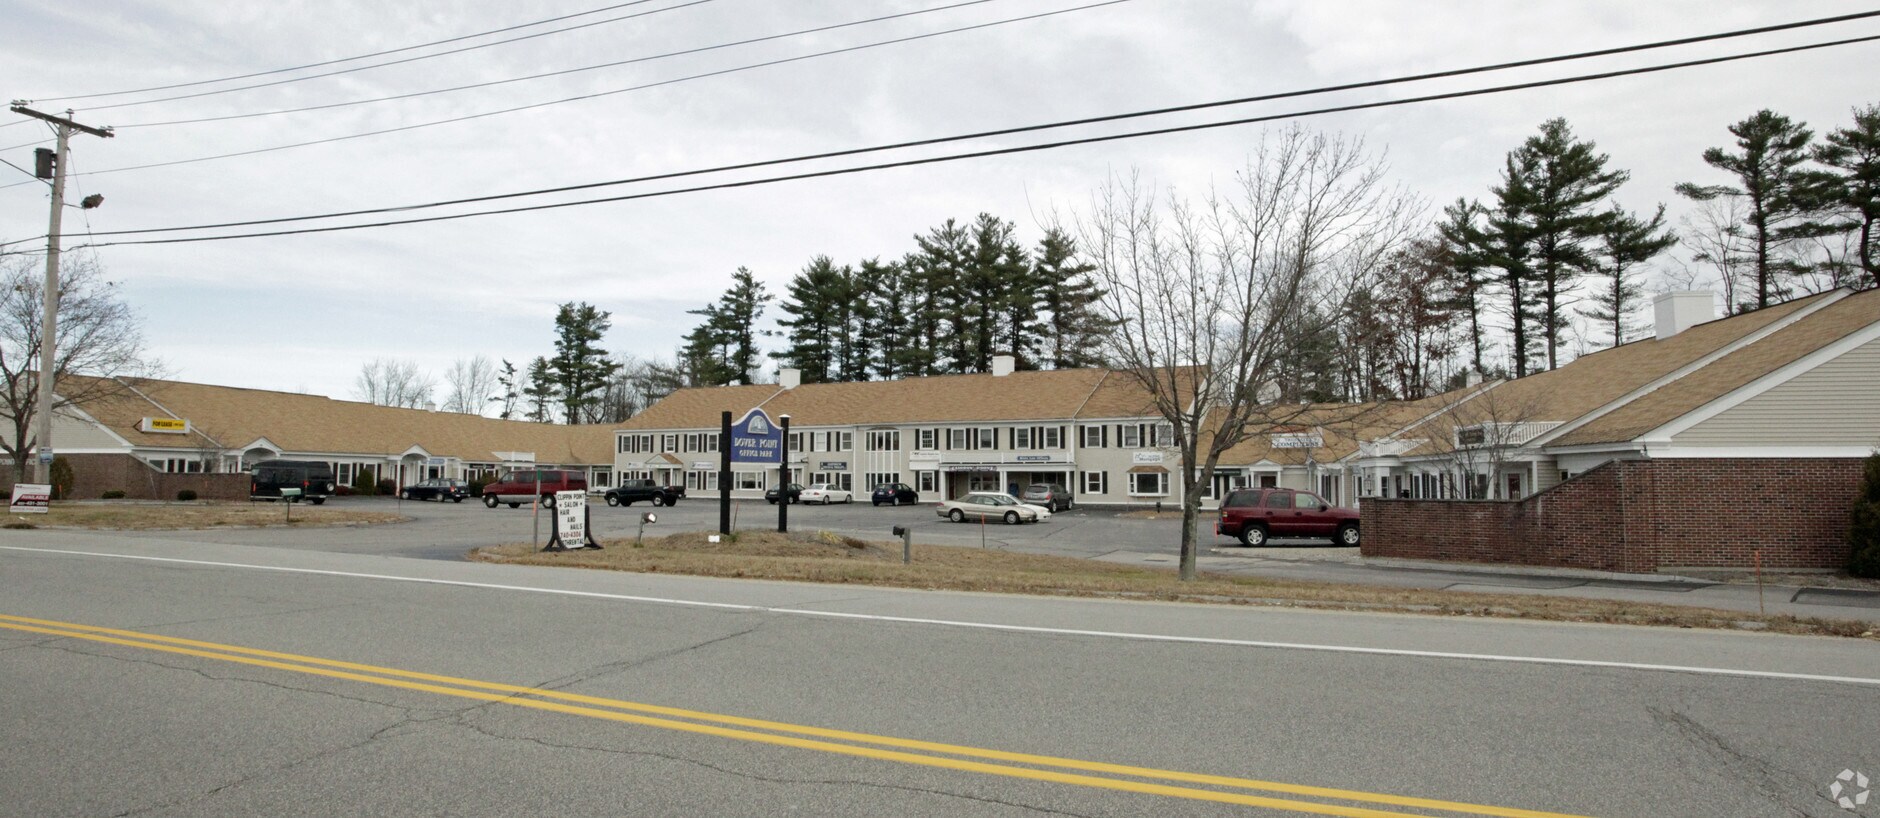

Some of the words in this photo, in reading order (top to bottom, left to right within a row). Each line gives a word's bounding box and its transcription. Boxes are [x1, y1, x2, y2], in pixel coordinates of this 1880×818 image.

[734, 437, 757, 448] DOVER
[759, 439, 778, 448] POINT
[739, 449, 758, 457] OFFICE
